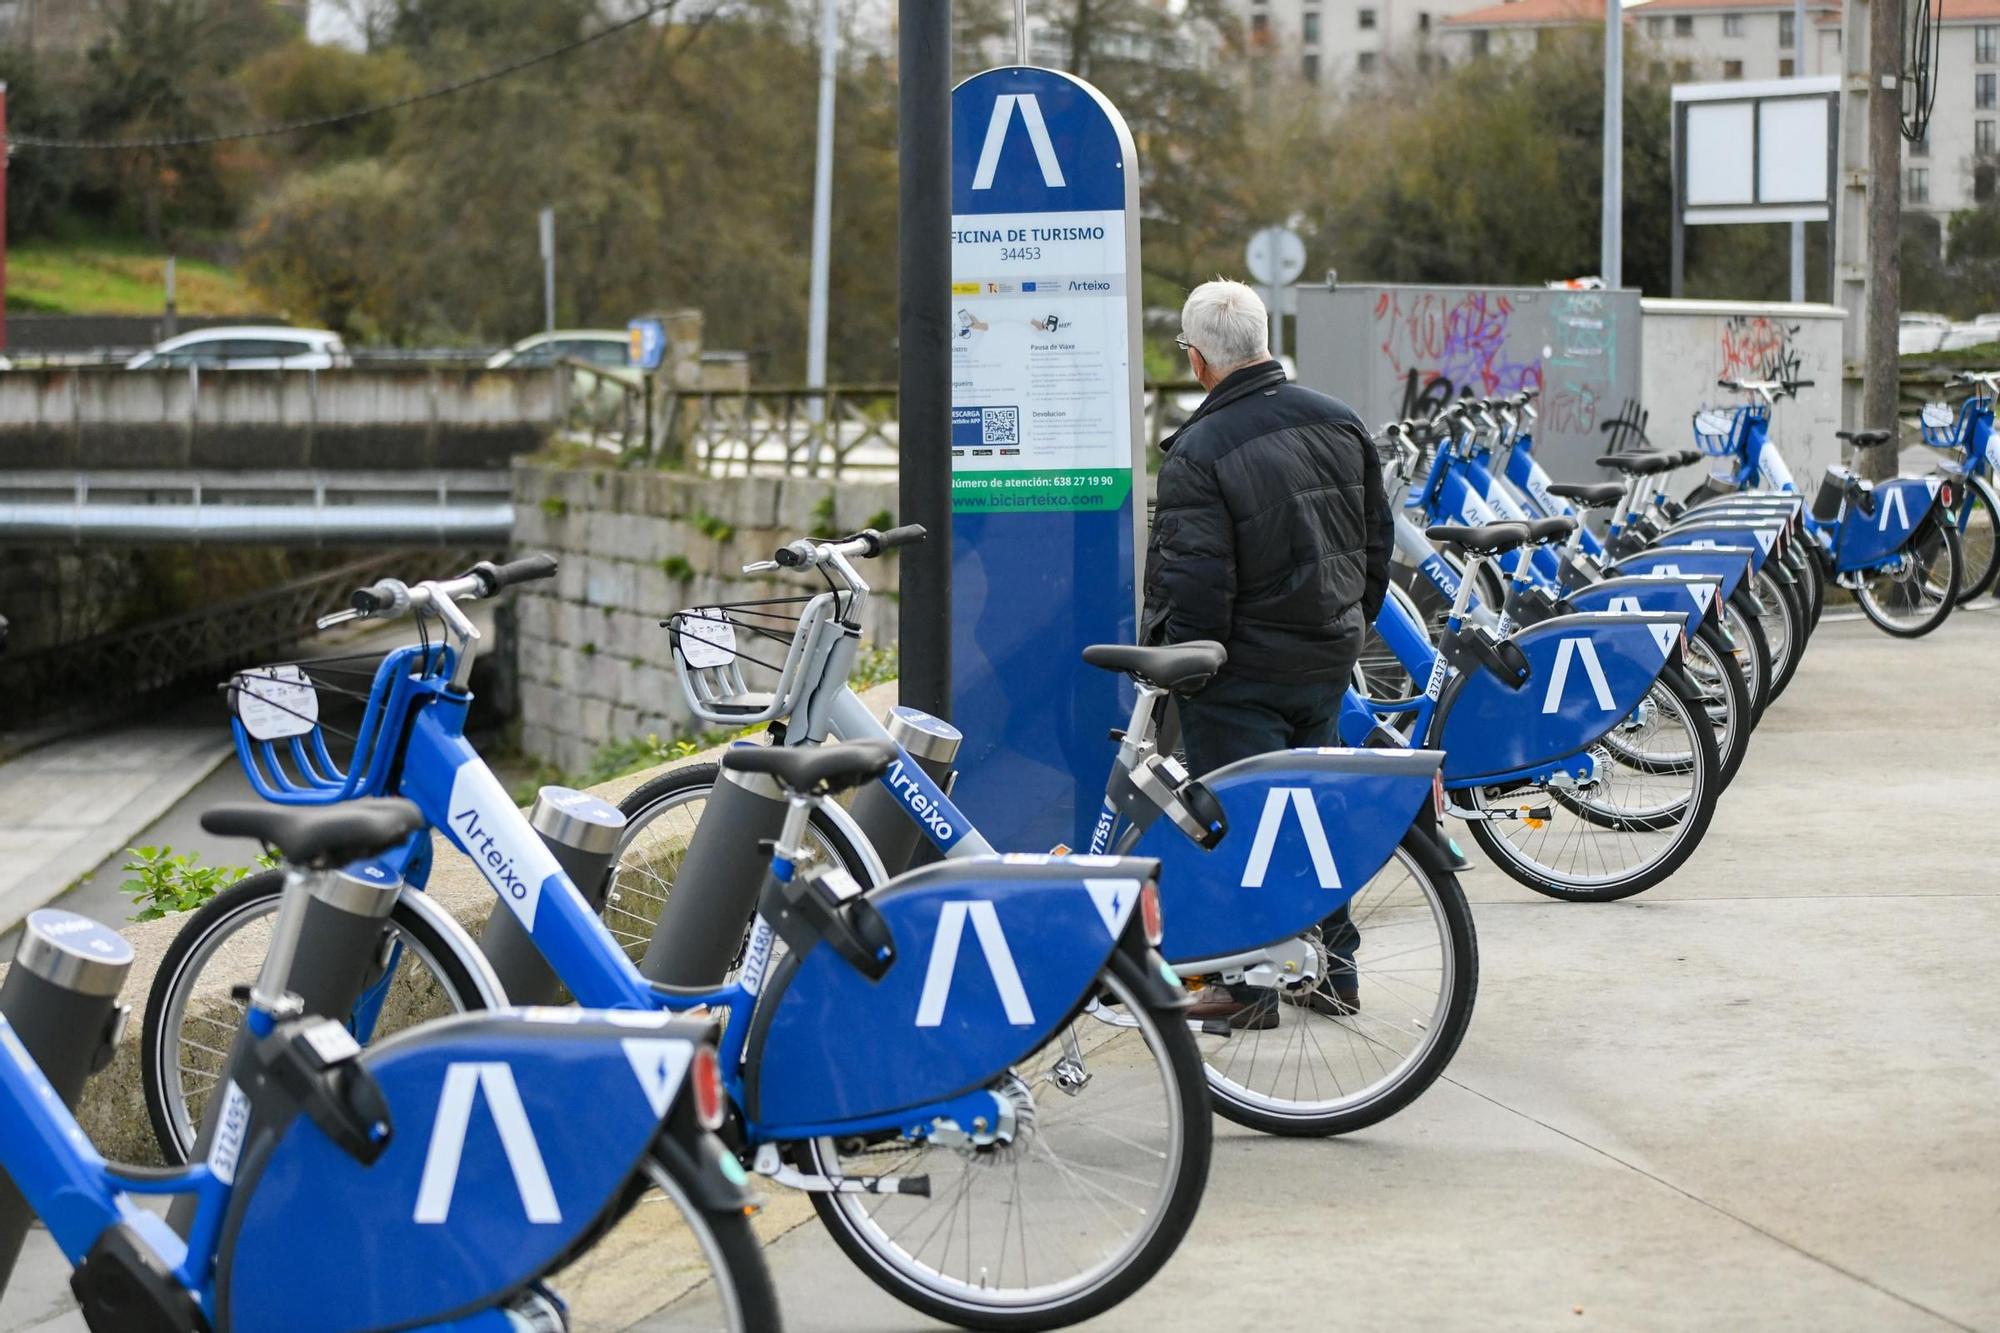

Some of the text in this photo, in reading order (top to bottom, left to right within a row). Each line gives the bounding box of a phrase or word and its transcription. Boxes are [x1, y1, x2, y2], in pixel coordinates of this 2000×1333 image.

[1008, 230, 1026, 242] DE
[1032, 227, 1104, 240] TURISMO
[1000, 248, 1041, 260] 34453
[1068, 280, 1110, 292] Arteixo
[990, 478, 1002, 488] de
[1004, 477, 1052, 487] atención:
[1054, 477, 1072, 486] 638
[1074, 477, 1086, 486] 27
[1088, 477, 1100, 486] 19
[1101, 476, 1113, 486] 90
[952, 494, 1104, 507] www.biciarteixo.com
[1429, 658, 1448, 697] 372473
[887, 759, 952, 840] Arteixo
[1089, 812, 1114, 856] 77551
[455, 810, 526, 900] Arteixo
[744, 926, 774, 986] 372480
